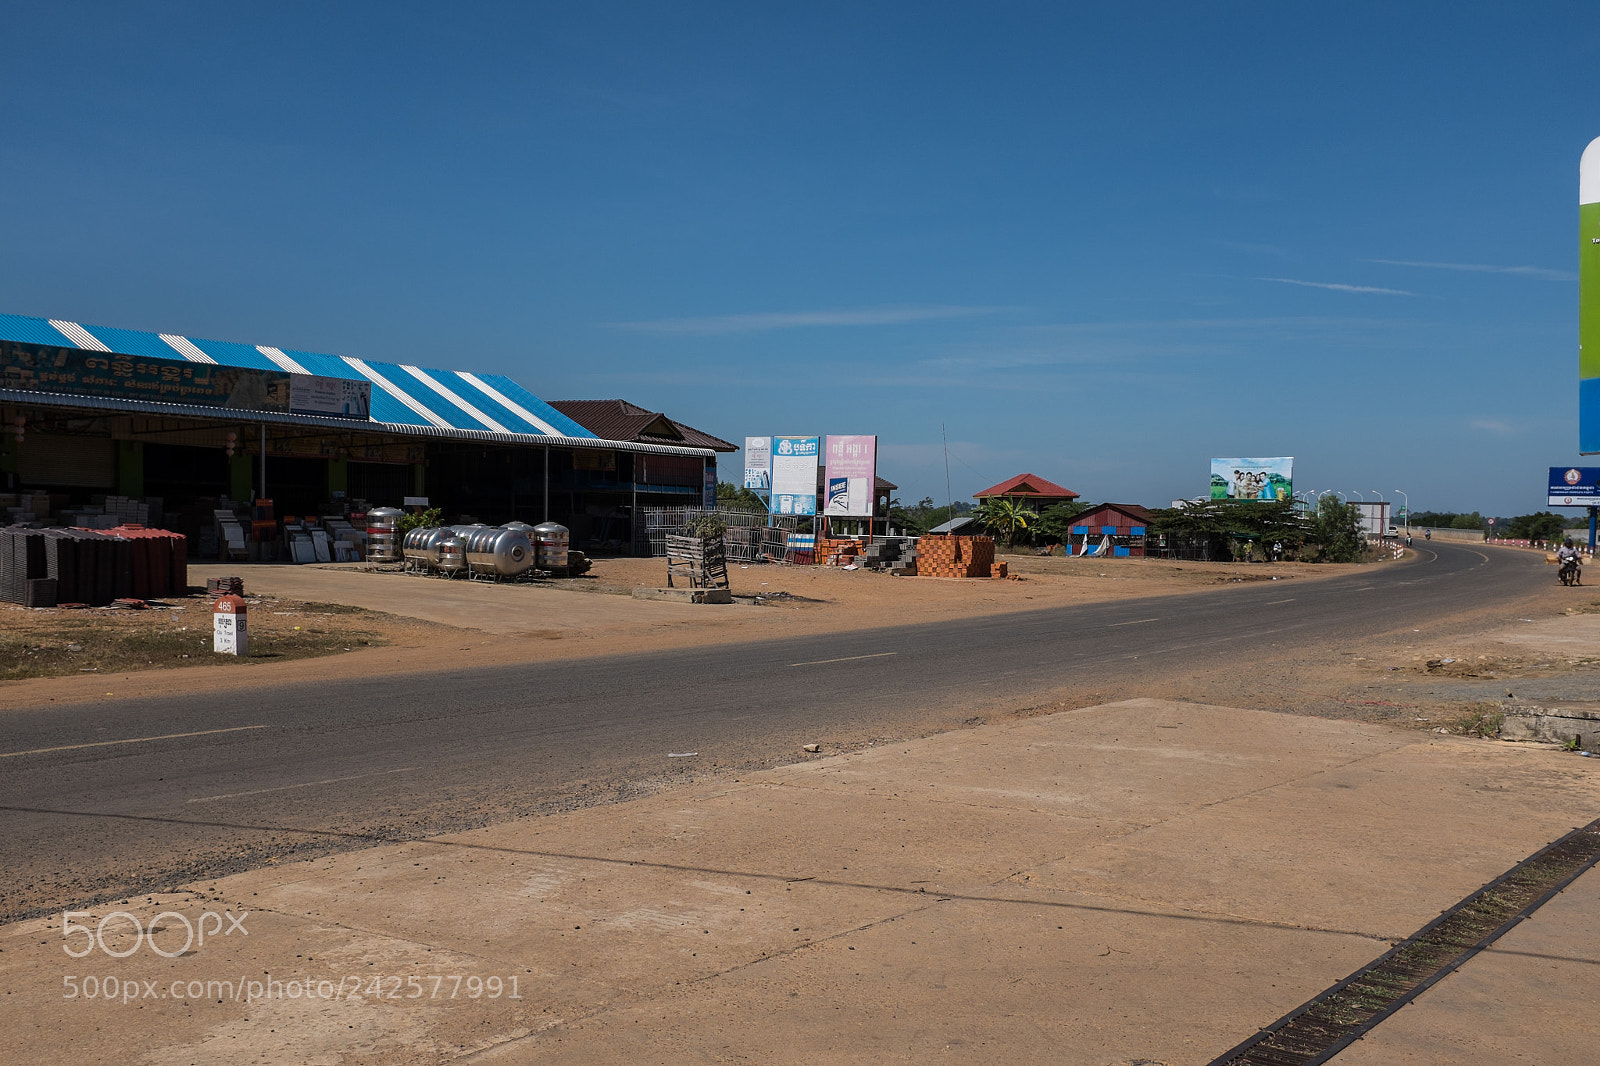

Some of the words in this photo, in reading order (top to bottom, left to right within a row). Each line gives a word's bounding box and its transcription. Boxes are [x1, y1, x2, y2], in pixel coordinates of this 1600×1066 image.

[831, 481, 846, 492] INSEE
[218, 602, 231, 611] 465
[239, 621, 245, 630] 9
